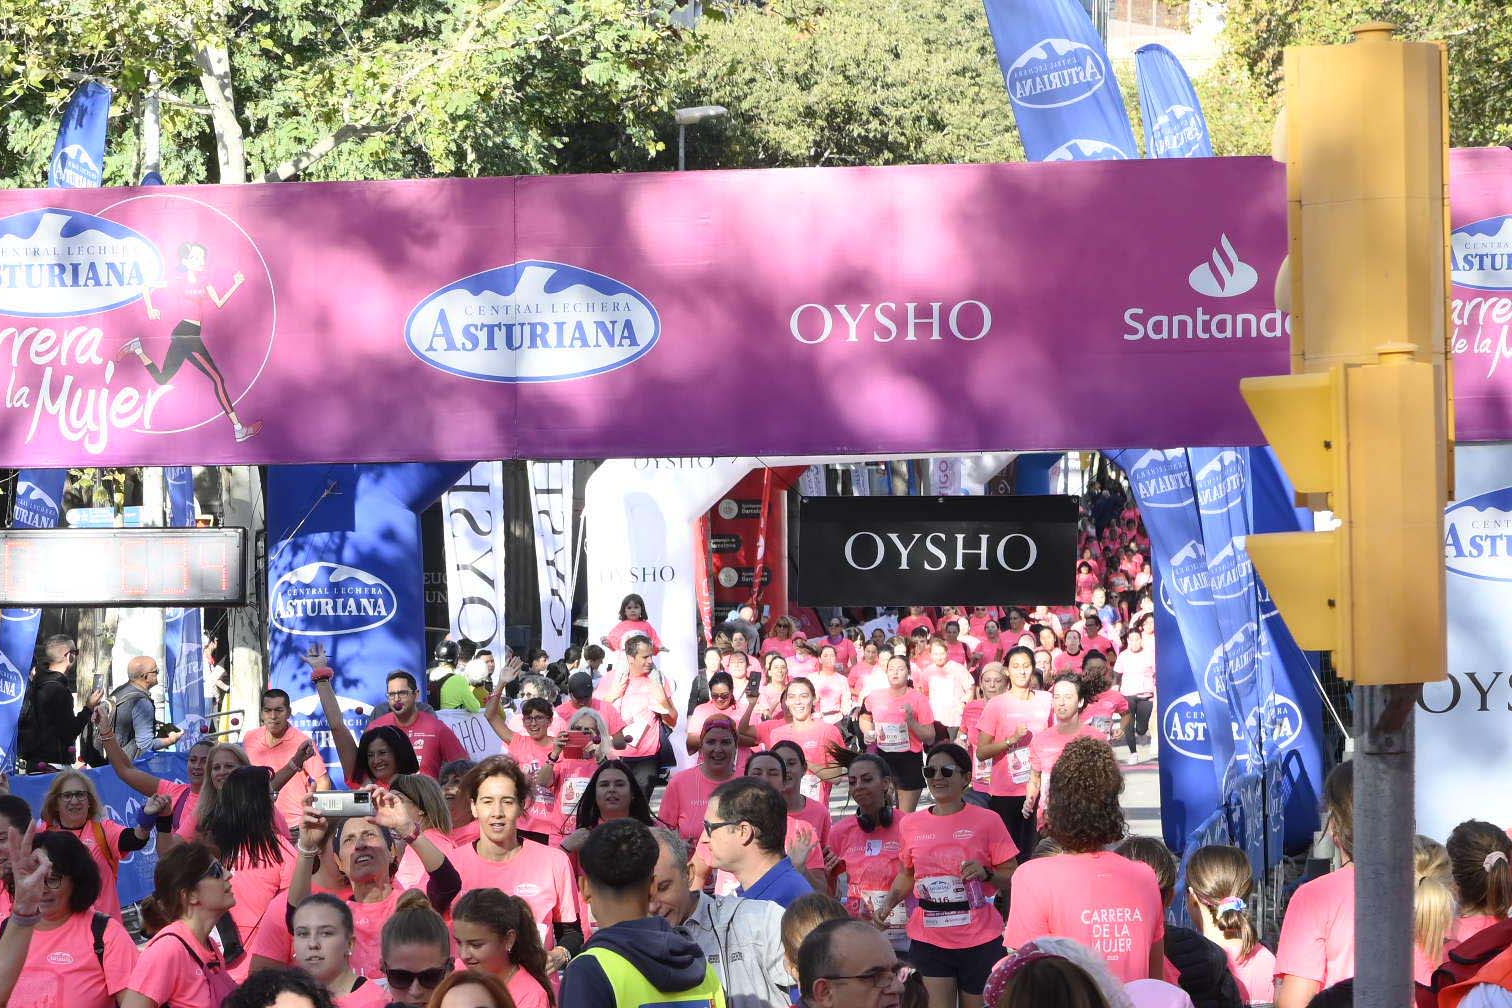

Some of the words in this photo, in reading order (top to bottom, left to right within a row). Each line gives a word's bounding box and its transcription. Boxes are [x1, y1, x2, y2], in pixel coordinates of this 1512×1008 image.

[465, 303, 543, 317] CENTRAL
[551, 301, 632, 314] LECHERA
[425, 308, 640, 352] ASTURIANA
[789, 300, 992, 344] OYSHO
[6, 367, 31, 408] la
[25, 359, 176, 455] Mujer
[844, 532, 1038, 572] OYSHO
[287, 586, 329, 595] CENTRAL
[334, 586, 383, 595] LECHERA
[274, 591, 388, 619] ASTURIANA
[1081, 908, 1144, 924] CARRERA
[1092, 924, 1110, 938] DE
[1115, 923, 1130, 937] LA
[1092, 939, 1132, 953] MUJER
